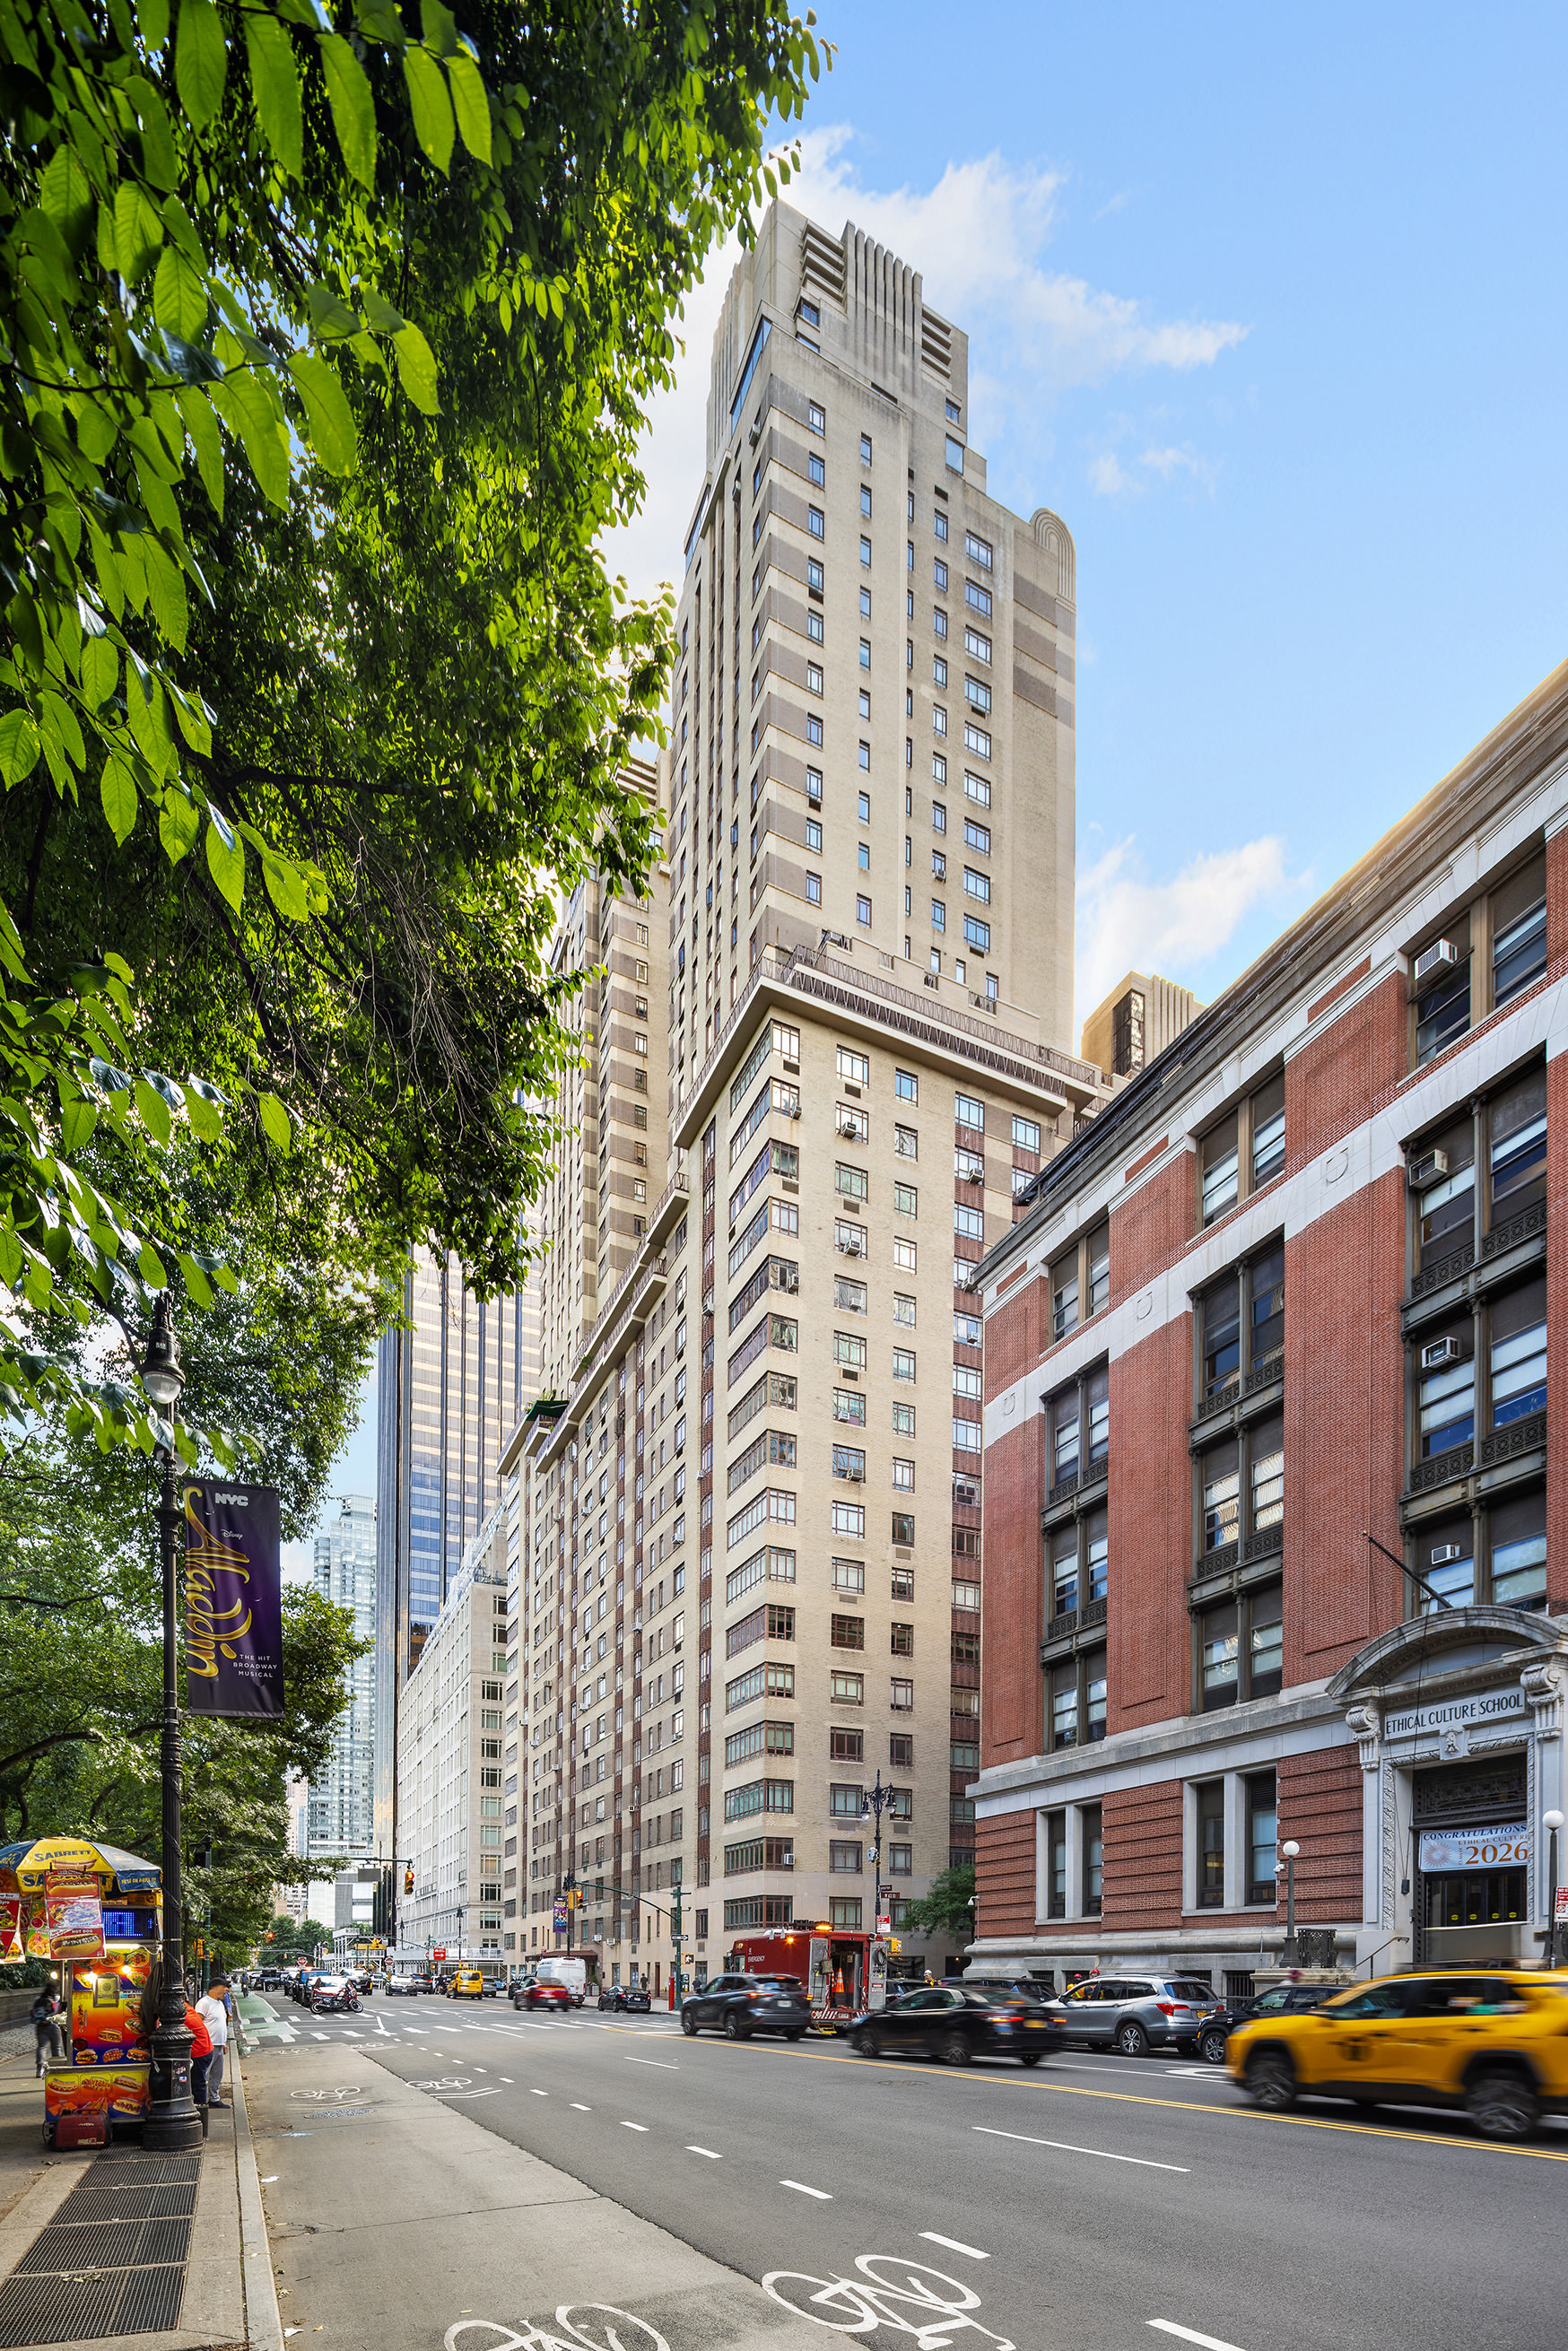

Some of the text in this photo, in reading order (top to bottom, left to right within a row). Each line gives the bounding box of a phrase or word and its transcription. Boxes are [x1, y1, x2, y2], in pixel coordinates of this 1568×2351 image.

[215, 1493, 248, 1507] NYC
[221, 1528, 243, 1540] Disney
[233, 1661, 277, 1669] BROADWAY
[238, 1670, 273, 1678] MUSICAL
[1386, 1694, 1523, 1734] ETHICAL CULTURE SCHOOL
[1423, 1824, 1527, 1841] CONGRATULATIONS
[34, 1850, 91, 1862] SABRETT
[1465, 1841, 1528, 1865] 2026
